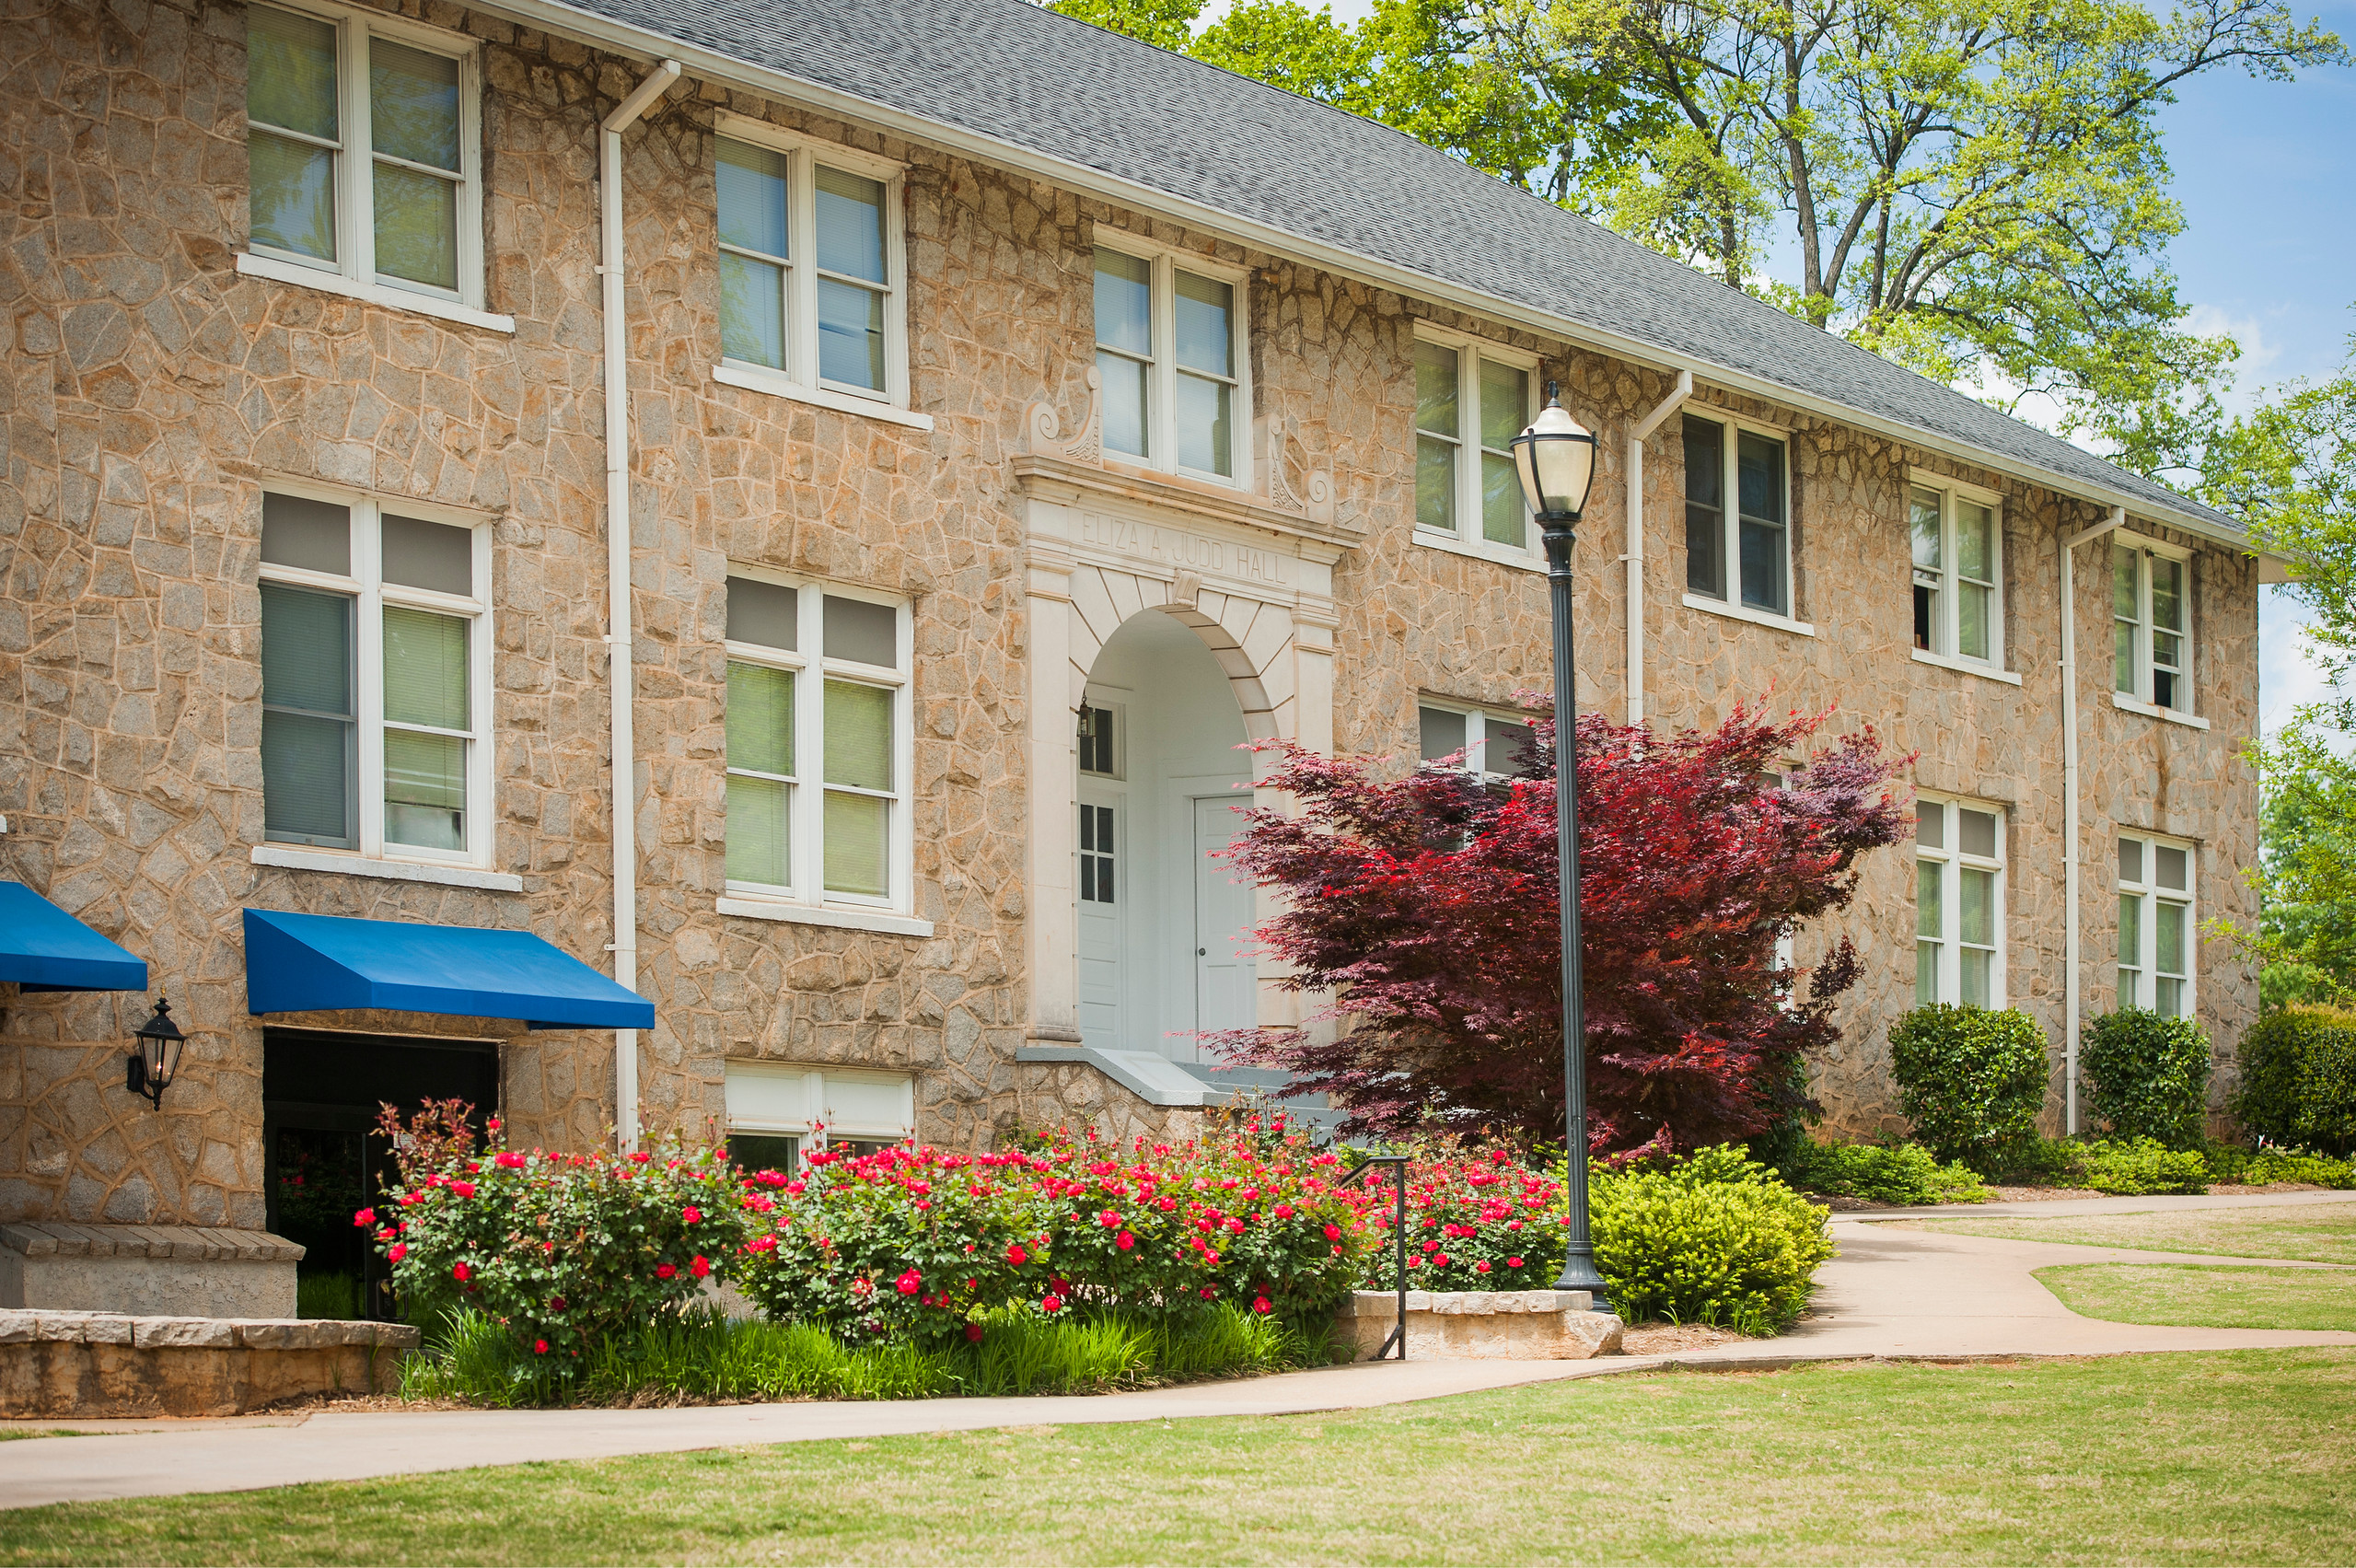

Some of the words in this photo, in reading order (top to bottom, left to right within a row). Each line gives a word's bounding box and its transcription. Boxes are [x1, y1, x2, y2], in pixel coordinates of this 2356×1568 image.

[1083, 513, 1140, 552] ELIZA
[1172, 534, 1224, 570] JUDD
[1236, 547, 1286, 584] HALL
